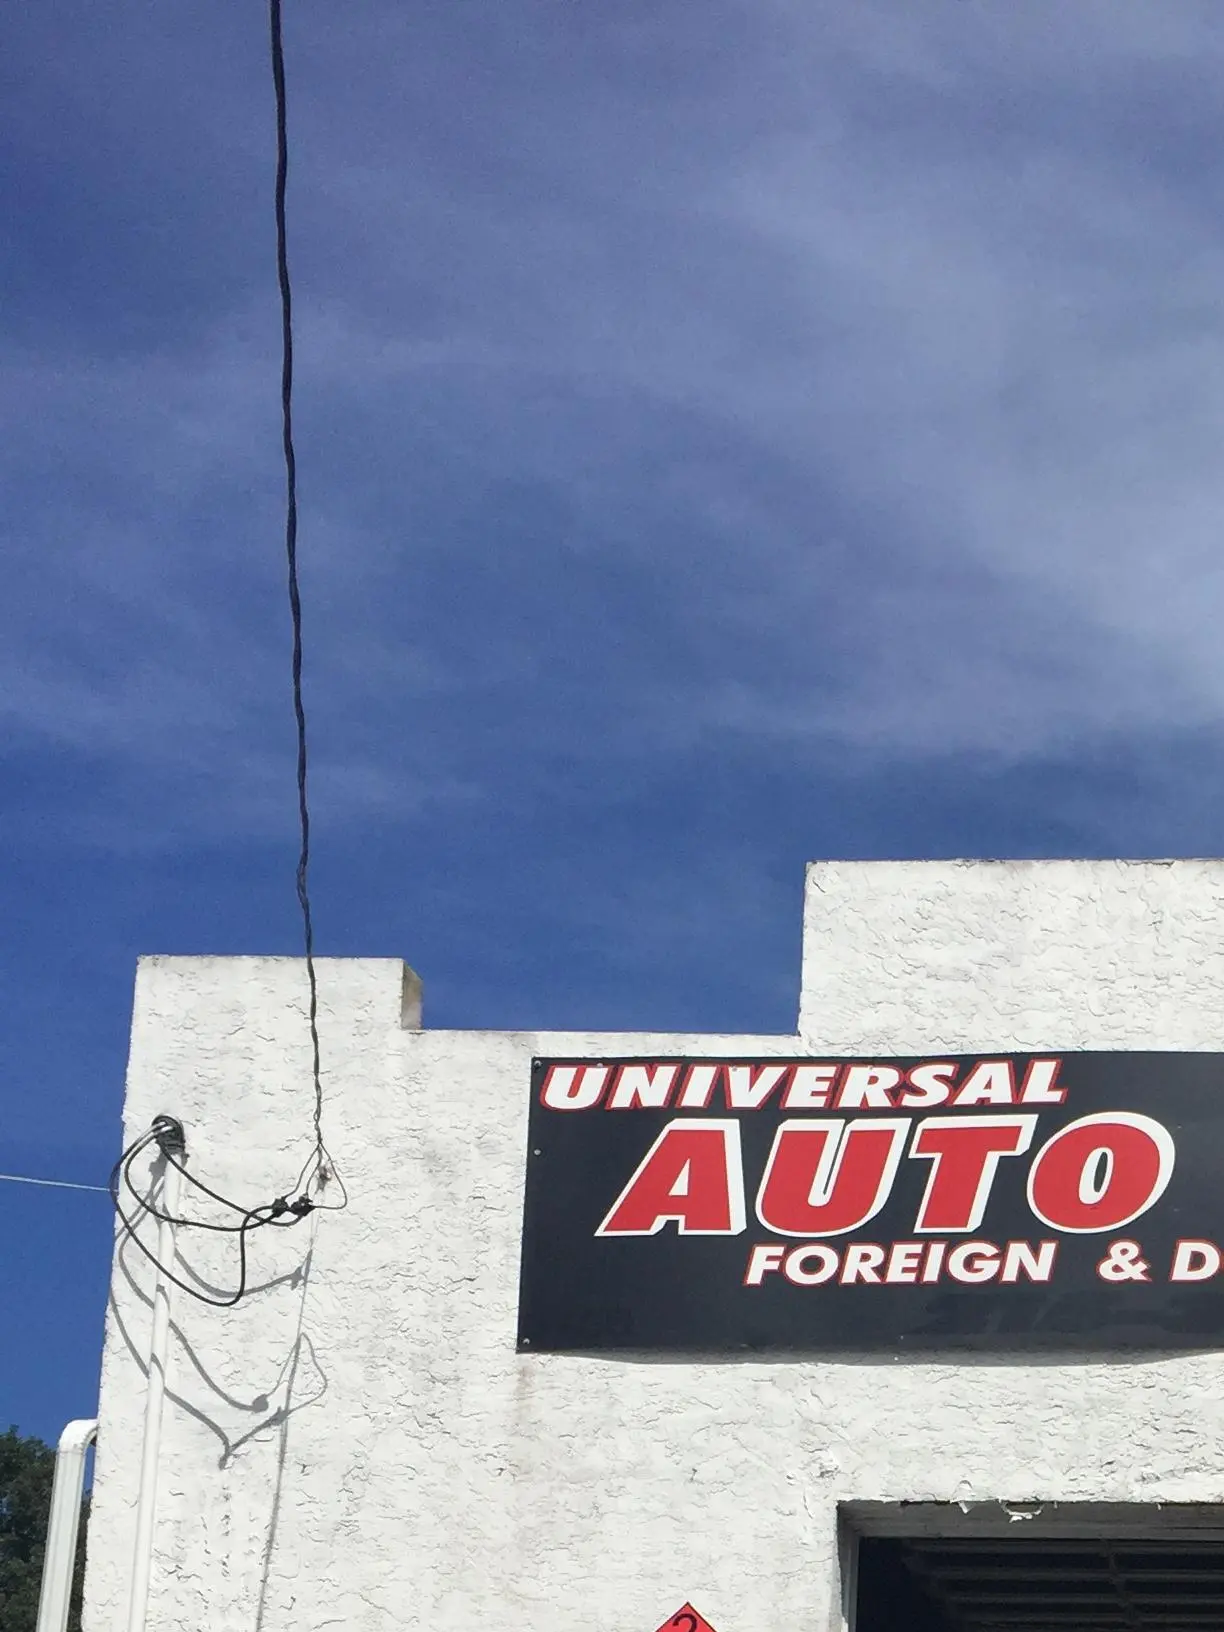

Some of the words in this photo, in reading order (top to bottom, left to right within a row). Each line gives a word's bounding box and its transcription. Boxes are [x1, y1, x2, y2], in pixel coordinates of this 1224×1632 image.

[540, 1059, 1068, 1110] UNIVERSAL
[594, 1111, 1176, 1237] AUTO
[744, 1241, 1060, 1286] FOREIGN
[1097, 1240, 1153, 1283] &
